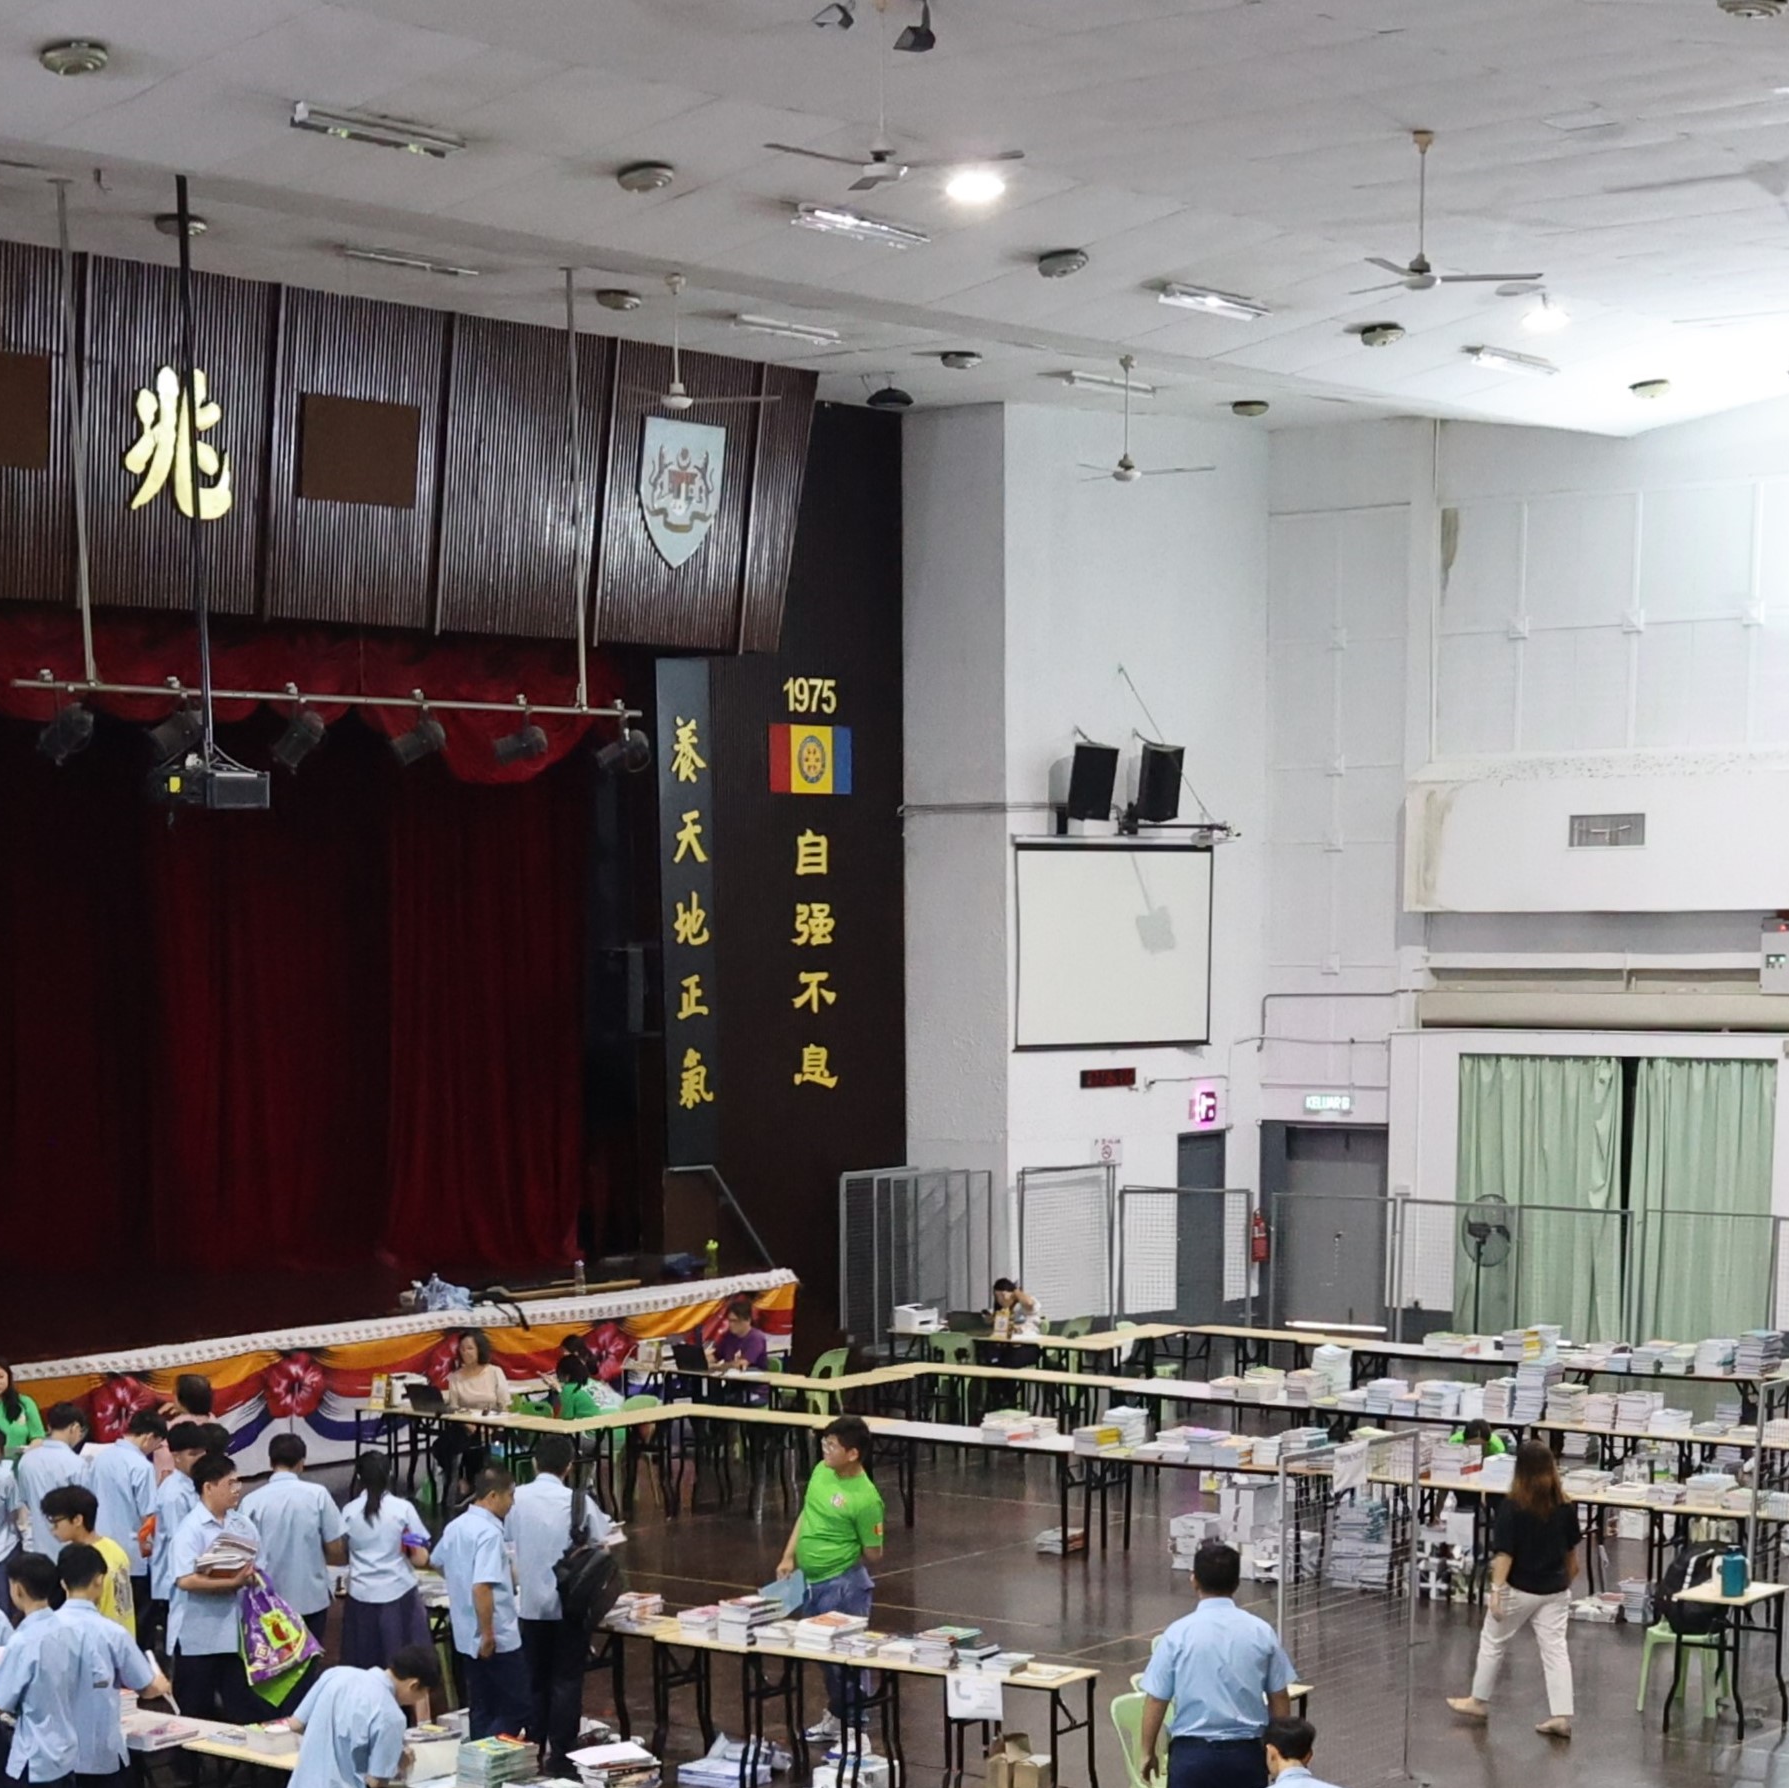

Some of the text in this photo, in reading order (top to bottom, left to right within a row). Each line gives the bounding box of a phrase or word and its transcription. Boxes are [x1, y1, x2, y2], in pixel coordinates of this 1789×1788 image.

[783, 677, 837, 714] 1975
[670, 716, 714, 1109] 養天地正氣
[1306, 1095, 1341, 1110] KELUAR
